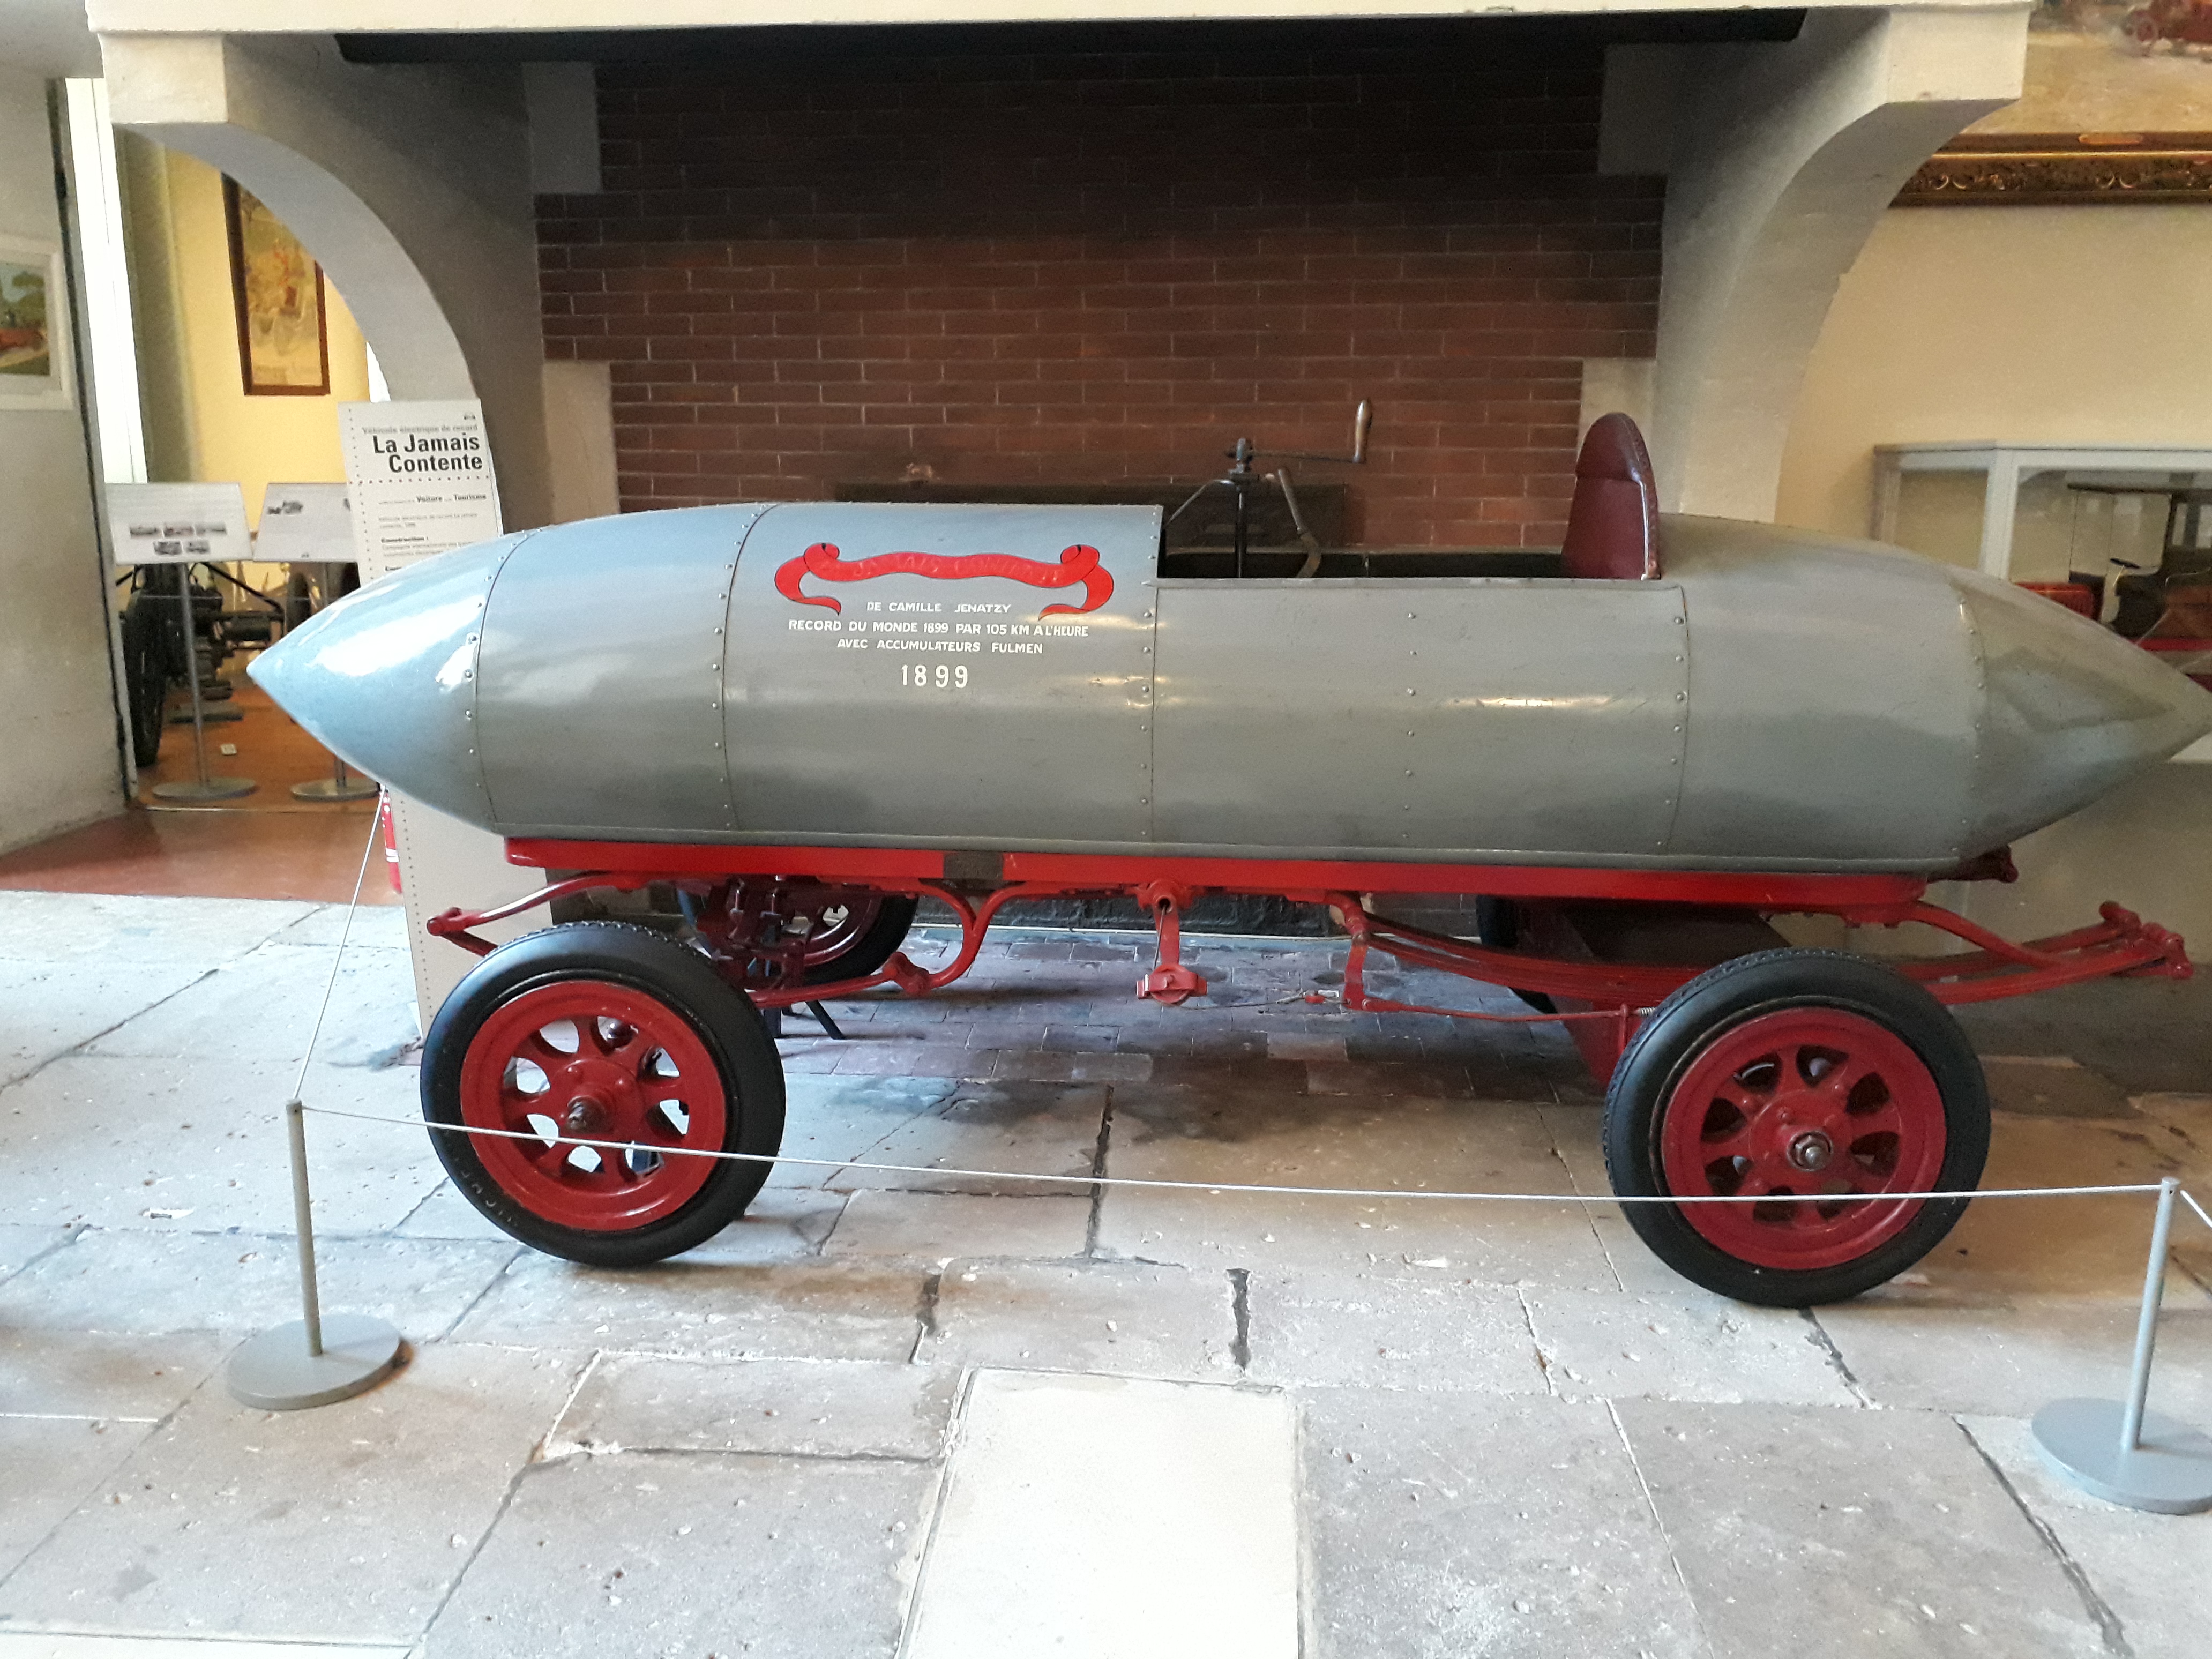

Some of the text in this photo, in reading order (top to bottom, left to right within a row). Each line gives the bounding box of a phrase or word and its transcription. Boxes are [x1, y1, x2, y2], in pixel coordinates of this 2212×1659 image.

[372, 432, 480, 453] La Jamais
[389, 454, 482, 473] Contente
[866, 601, 1012, 614] DE CAMILLE JENATZY
[788, 619, 842, 631] RECORD
[848, 620, 867, 632] DU
[872, 621, 918, 633] MONDE
[923, 622, 949, 634] 1899
[956, 623, 982, 635] PAR
[986, 624, 1007, 636] 105
[1011, 624, 1030, 636] KM
[1044, 625, 1089, 637] L'HEURE
[837, 638, 1043, 654] AVEC ACCUMULATEURS FULMEN
[901, 664, 969, 689] 1899
